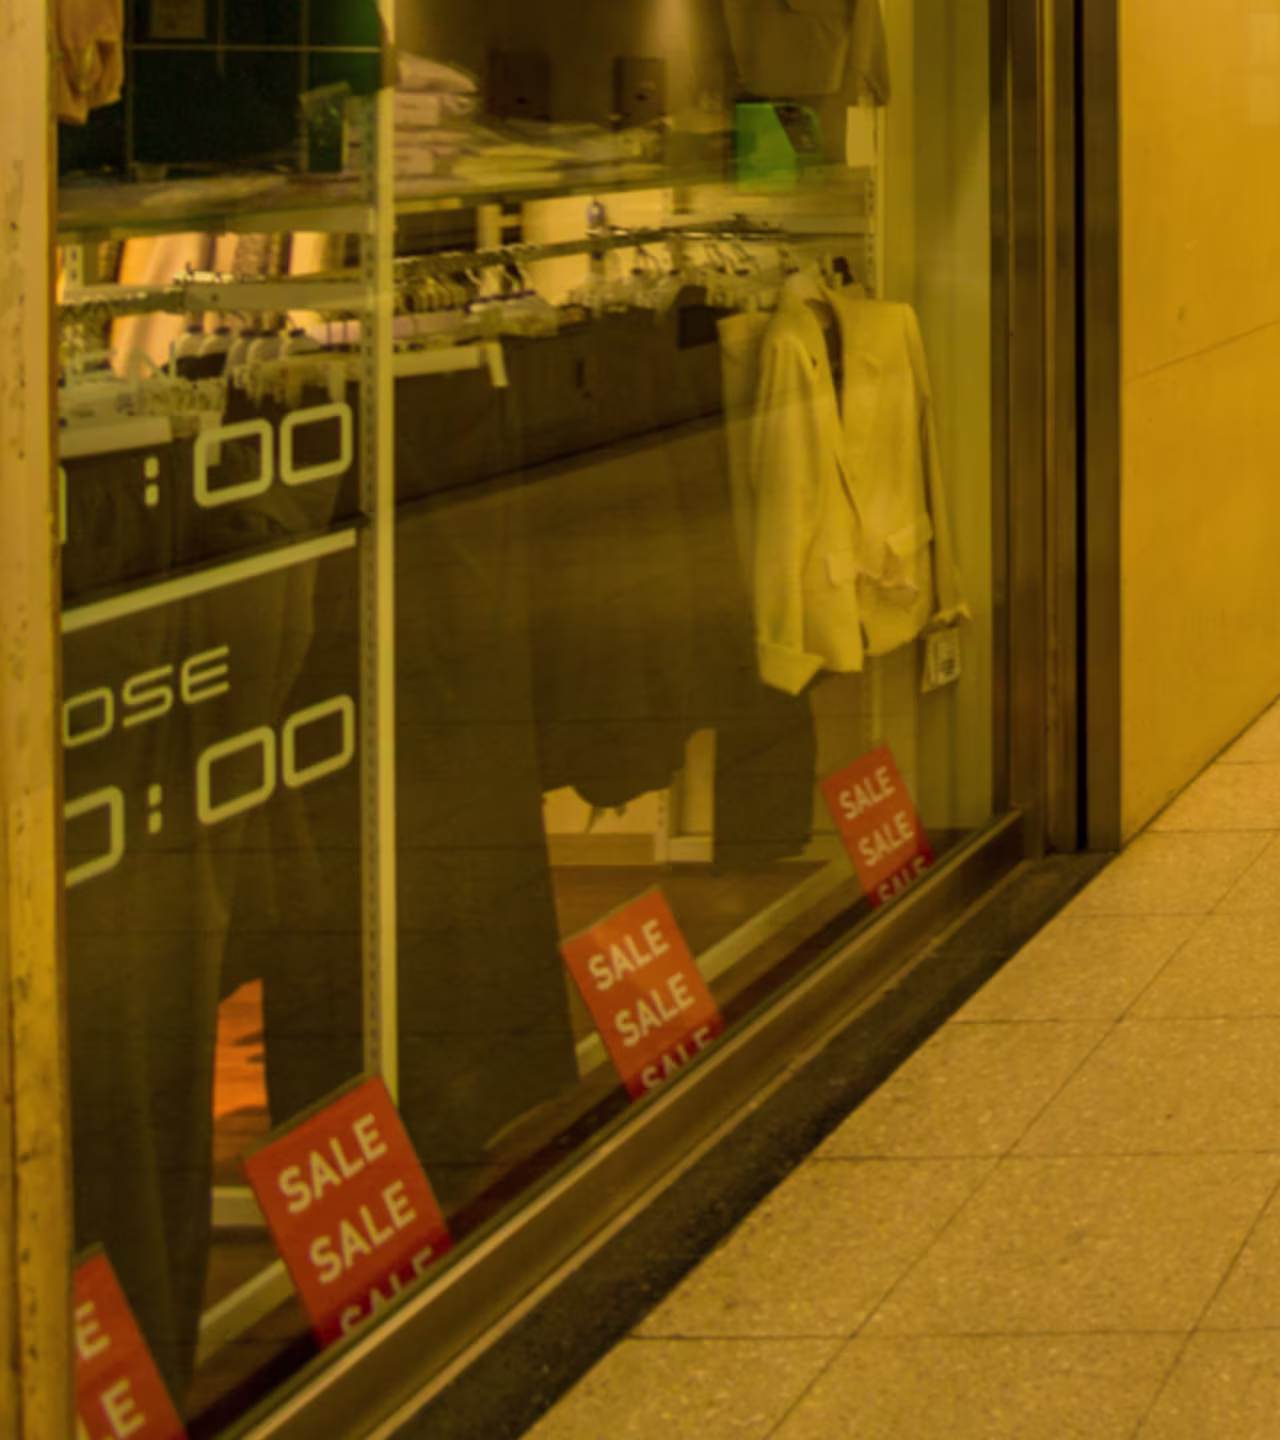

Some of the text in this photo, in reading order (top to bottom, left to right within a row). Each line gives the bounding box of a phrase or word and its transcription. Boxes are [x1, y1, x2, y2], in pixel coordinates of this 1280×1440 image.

[63, 645, 230, 748] OSE
[838, 765, 897, 821] SALE
[858, 811, 914, 867] SALE
[588, 918, 670, 992] SALE
[614, 971, 696, 1048] SALE
[277, 1112, 389, 1213] SALE
[309, 1179, 418, 1285] SALE
